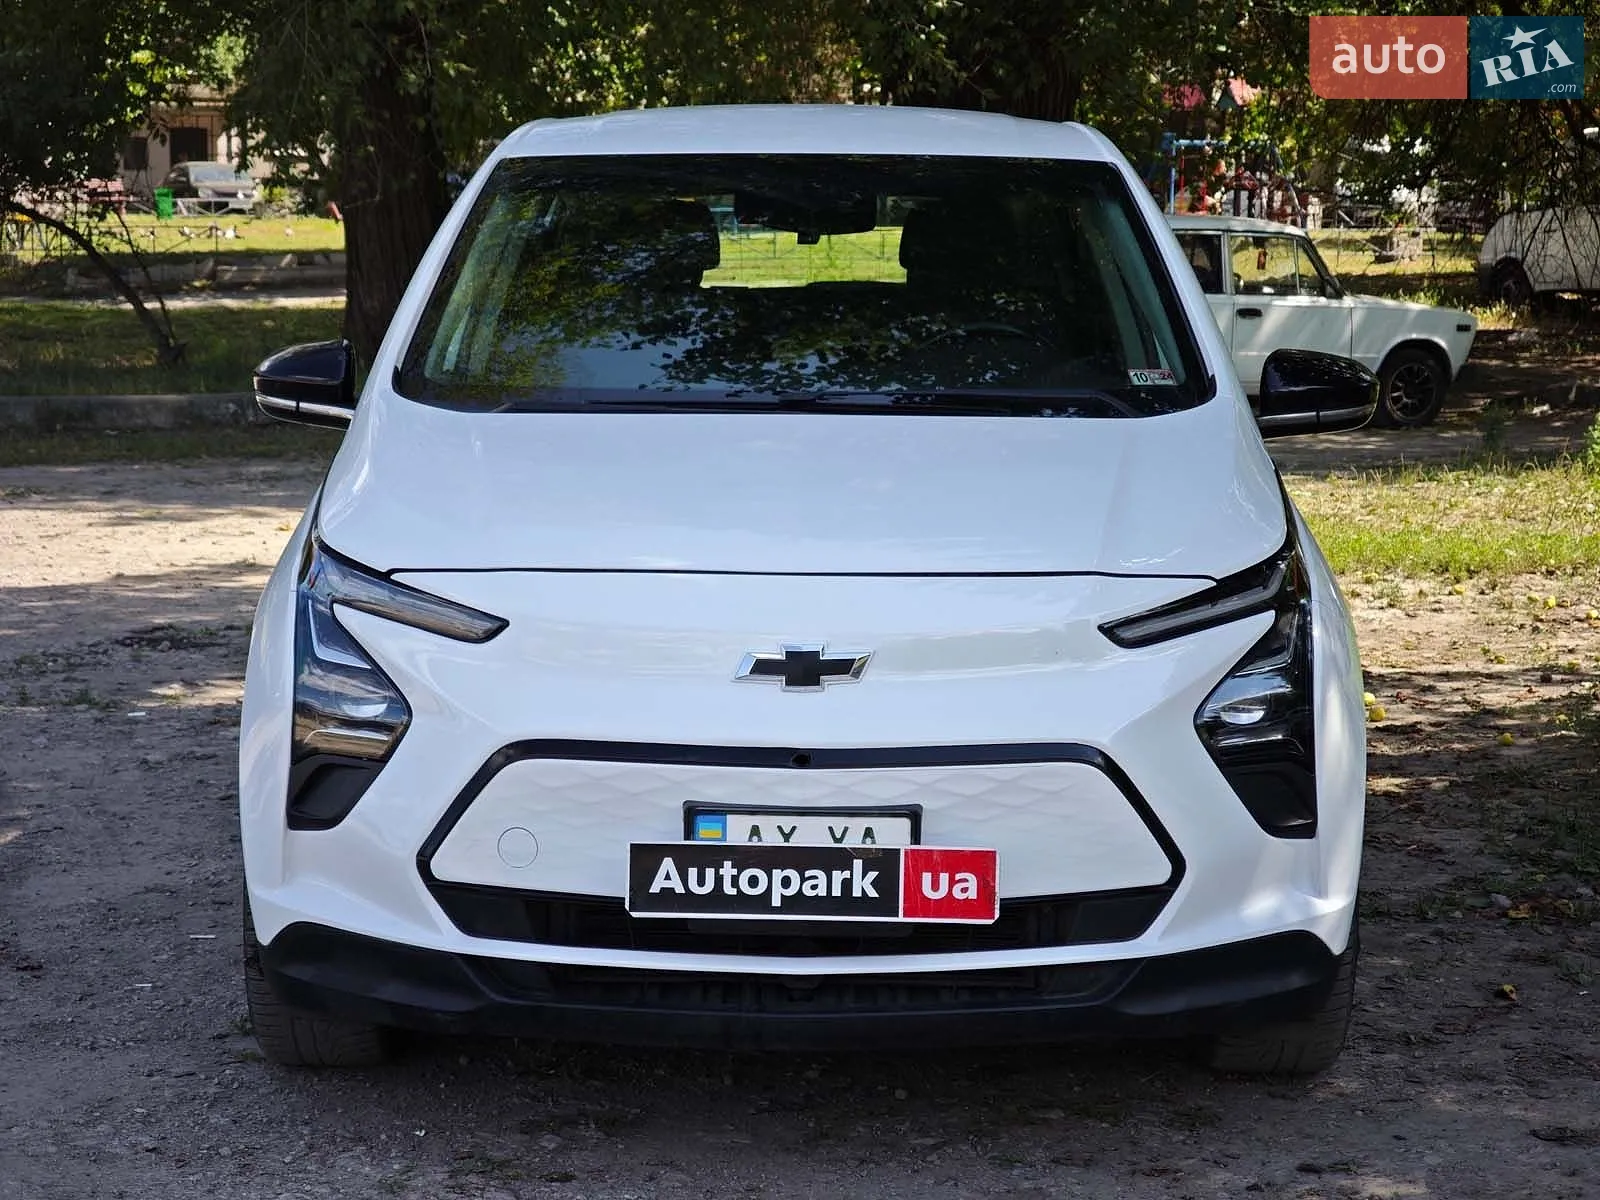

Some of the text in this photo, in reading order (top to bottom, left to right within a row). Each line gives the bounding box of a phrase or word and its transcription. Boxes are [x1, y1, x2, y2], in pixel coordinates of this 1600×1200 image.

[1133, 372, 1149, 383] 10
[648, 857, 978, 907] Autopark ua
